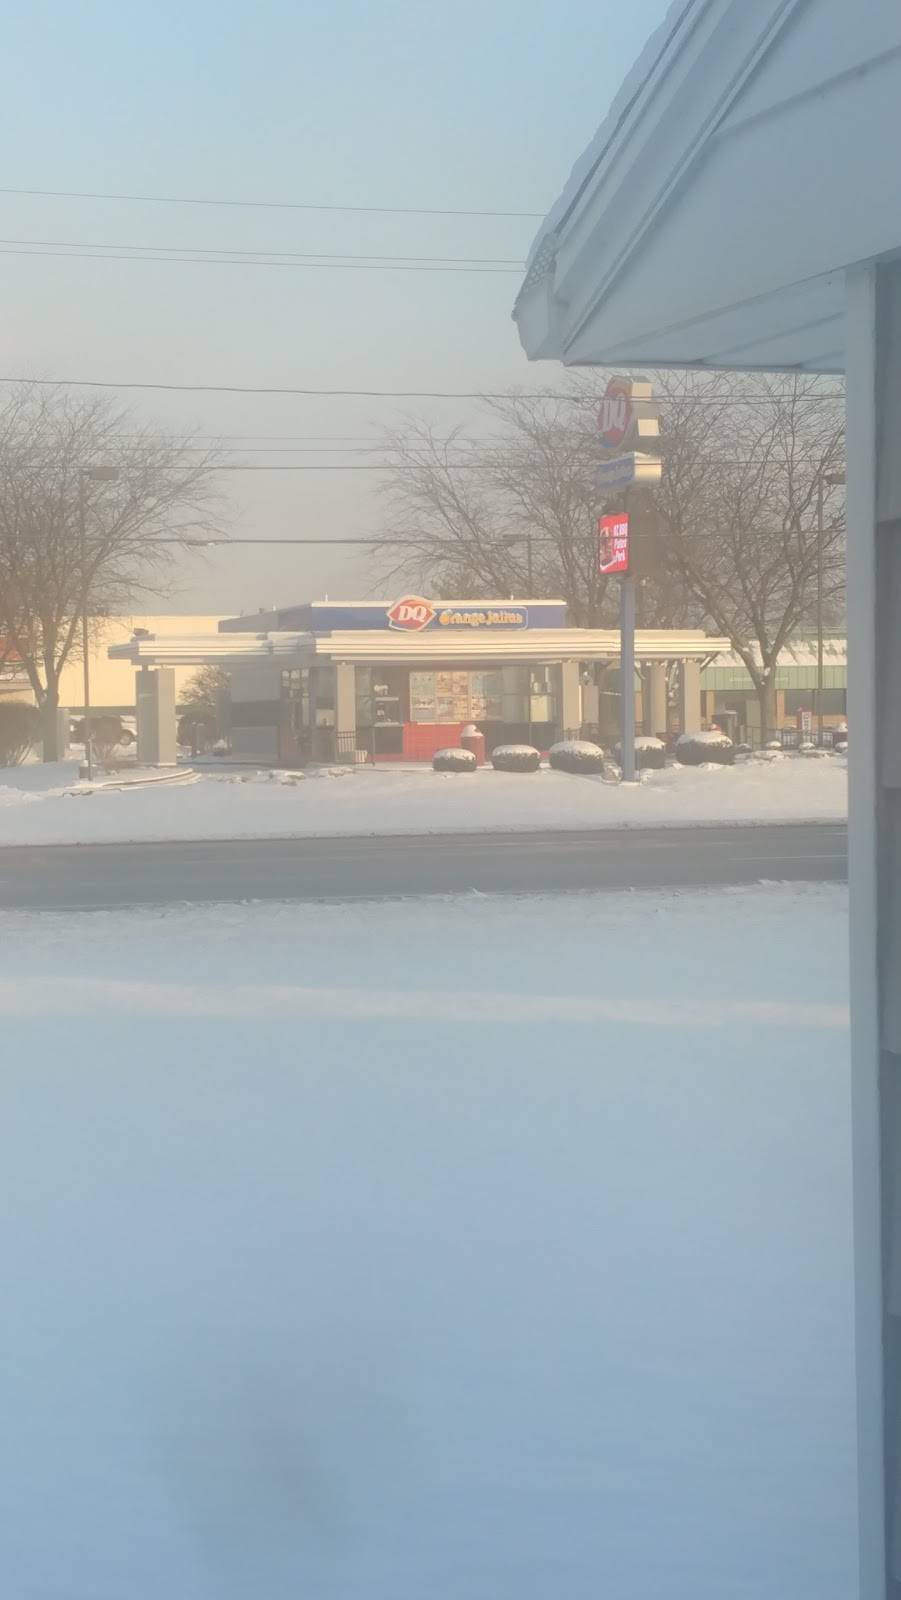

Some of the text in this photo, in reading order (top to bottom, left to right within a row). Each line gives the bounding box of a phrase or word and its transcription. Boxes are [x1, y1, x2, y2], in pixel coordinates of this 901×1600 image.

[601, 393, 626, 432] DQ
[398, 605, 427, 622] DQ
[439, 609, 485, 626] Orange
